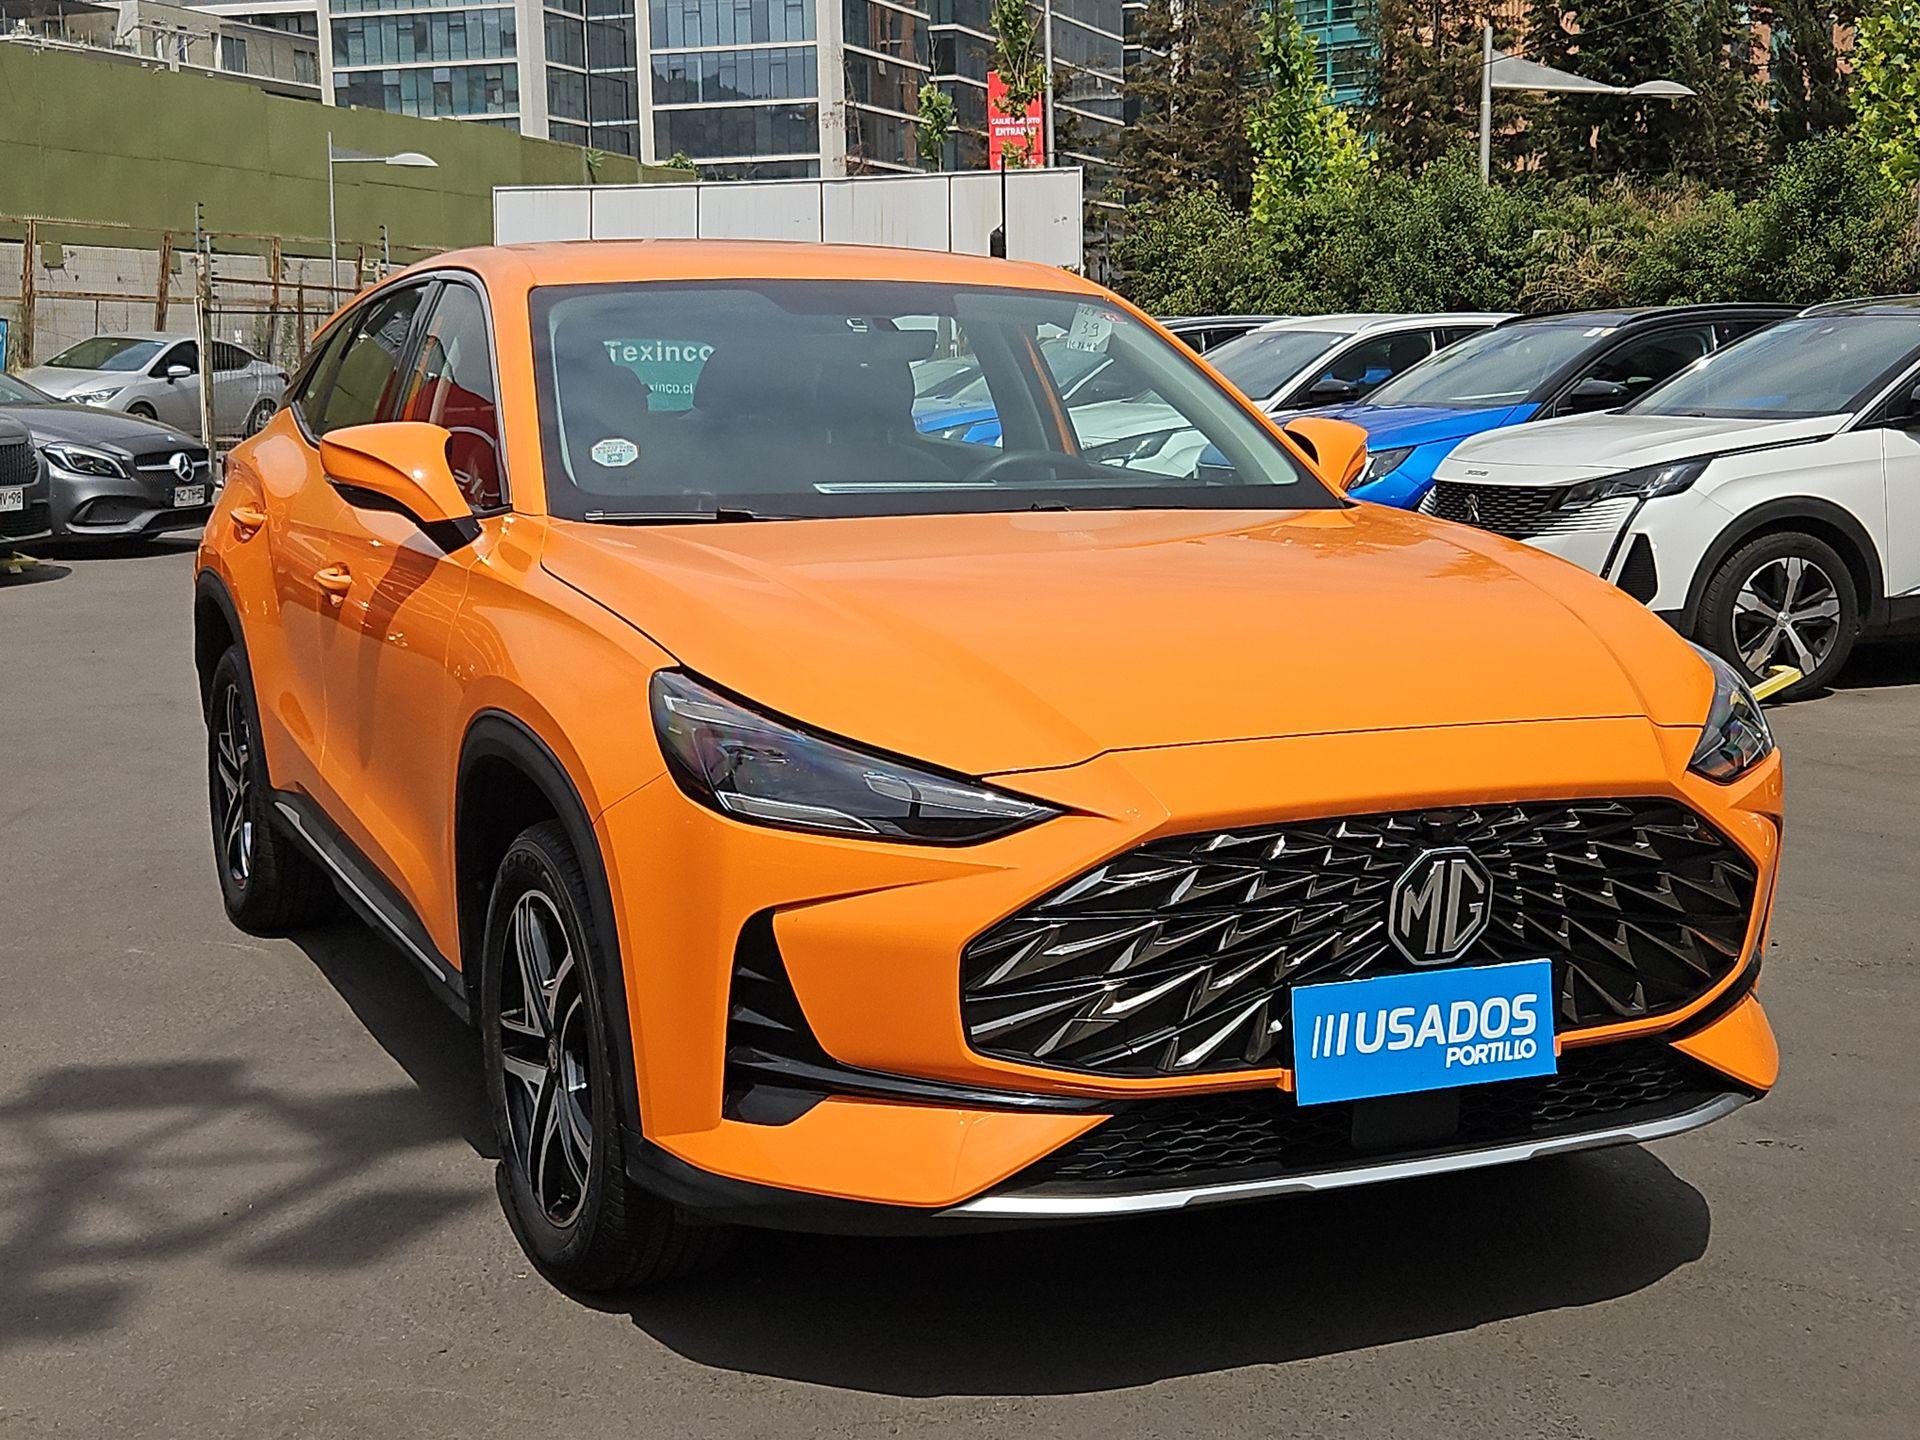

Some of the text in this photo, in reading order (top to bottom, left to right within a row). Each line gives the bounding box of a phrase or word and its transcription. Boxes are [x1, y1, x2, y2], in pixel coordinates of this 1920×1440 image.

[1080, 320, 1099, 337] 39
[603, 340, 716, 362] Texinco
[1401, 859, 1485, 954] MG
[1355, 993, 1538, 1054] USADOS
[1445, 1038, 1537, 1068] PORTILLO
